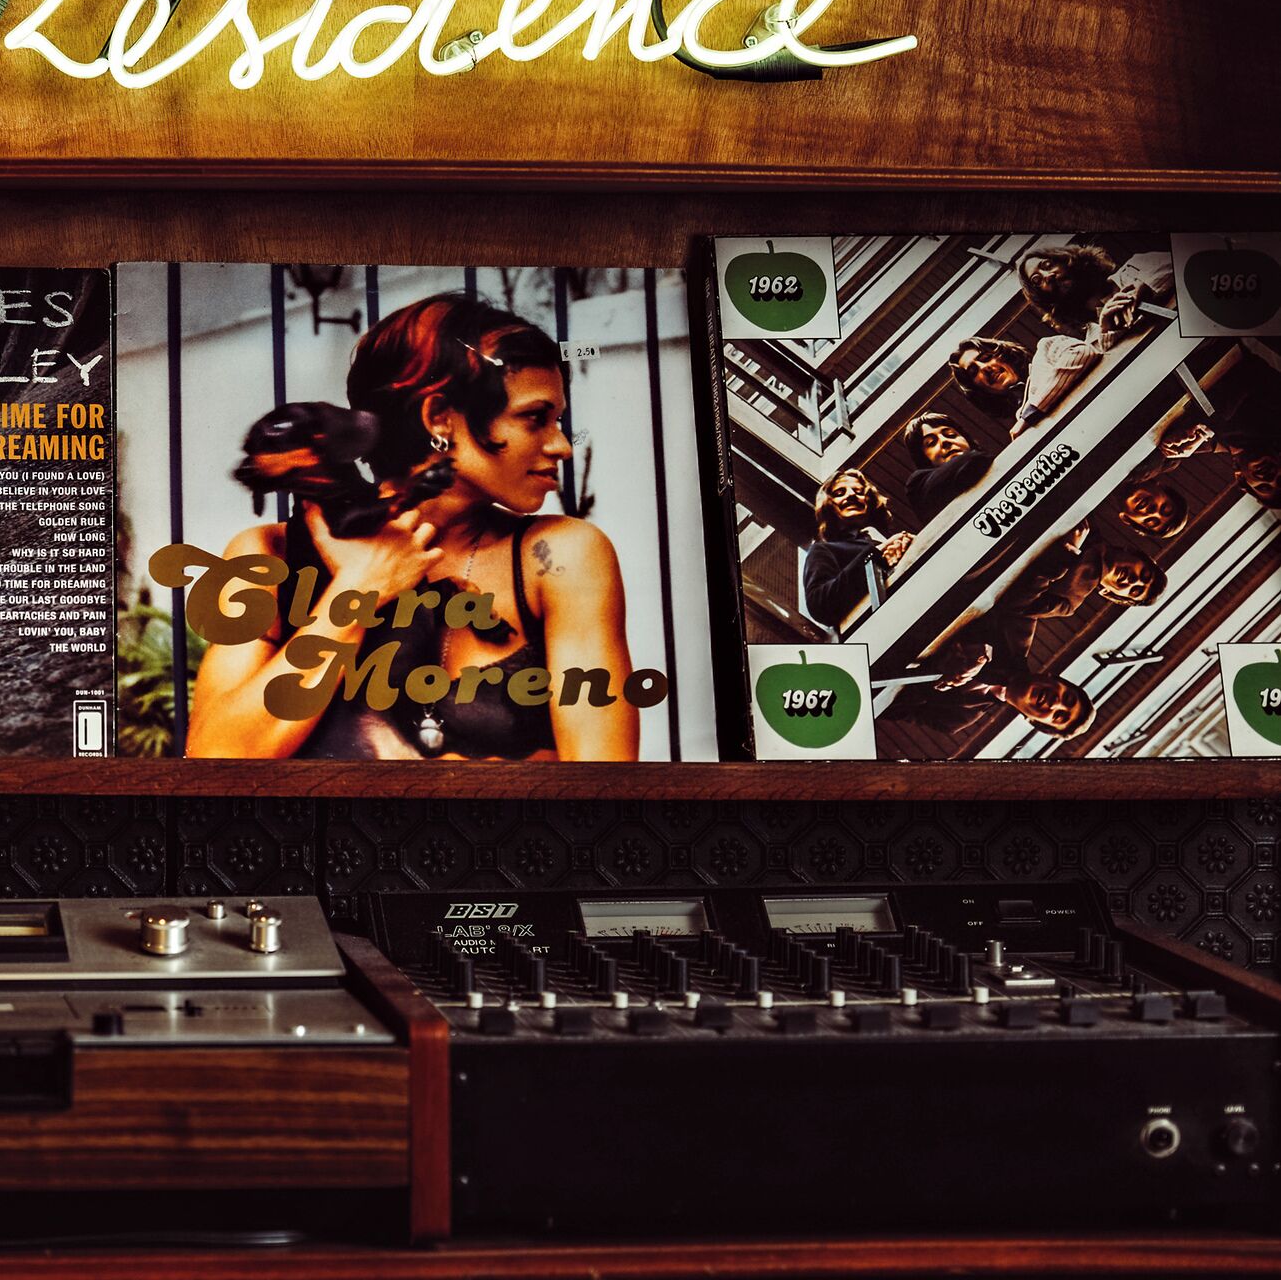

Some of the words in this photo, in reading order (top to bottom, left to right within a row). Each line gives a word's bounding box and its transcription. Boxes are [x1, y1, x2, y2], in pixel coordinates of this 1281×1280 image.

[749, 275, 801, 298] 1962
[1210, 273, 1260, 295] 1966
[576, 347, 595, 357] 2.50
[57, 403, 104, 429] FOR
[0, 471, 19, 482] YOU
[21, 471, 29, 482] (I
[32, 471, 64, 482] FOUND
[67, 471, 74, 482] A
[77, 471, 105, 482] LOVE)
[39, 487, 49, 496] IN
[52, 487, 78, 496] YOUR
[80, 487, 105, 496] LOVE
[973, 500, 1018, 537] The
[1005, 444, 1077, 506] Beatles
[0, 502, 17, 511] THE
[20, 502, 76, 511] TELEPHONE
[78, 502, 106, 511] SONG
[38, 518, 77, 526] GOLDEN
[80, 518, 106, 526] RULE
[54, 533, 76, 542] HOW
[79, 533, 106, 542] LONG
[11, 548, 34, 557] WHY
[37, 548, 47, 557] IS
[50, 548, 60, 557] IT
[62, 548, 76, 557] SO
[78, 548, 106, 557] HARD
[45, 564, 55, 573] IN
[58, 564, 76, 573] THE
[79, 564, 106, 573] LAND
[5, 580, 28, 589] TIME
[31, 580, 51, 589] FOR
[54, 580, 106, 589] DREAMING
[148, 544, 503, 645] Clara
[8, 596, 29, 604] OUR
[32, 596, 57, 604] LAST
[59, 596, 106, 604] GOODBYE
[59, 611, 80, 620] AND
[83, 611, 106, 620] PAIN
[19, 627, 51, 637] LOVIN'
[54, 627, 77, 637] YOU,
[79, 627, 106, 637] BABY
[49, 643, 68, 653] THE
[70, 643, 106, 653] WORLD
[263, 634, 668, 721] Moreno
[782, 688, 835, 713] 1967
[444, 903, 520, 919] BST
